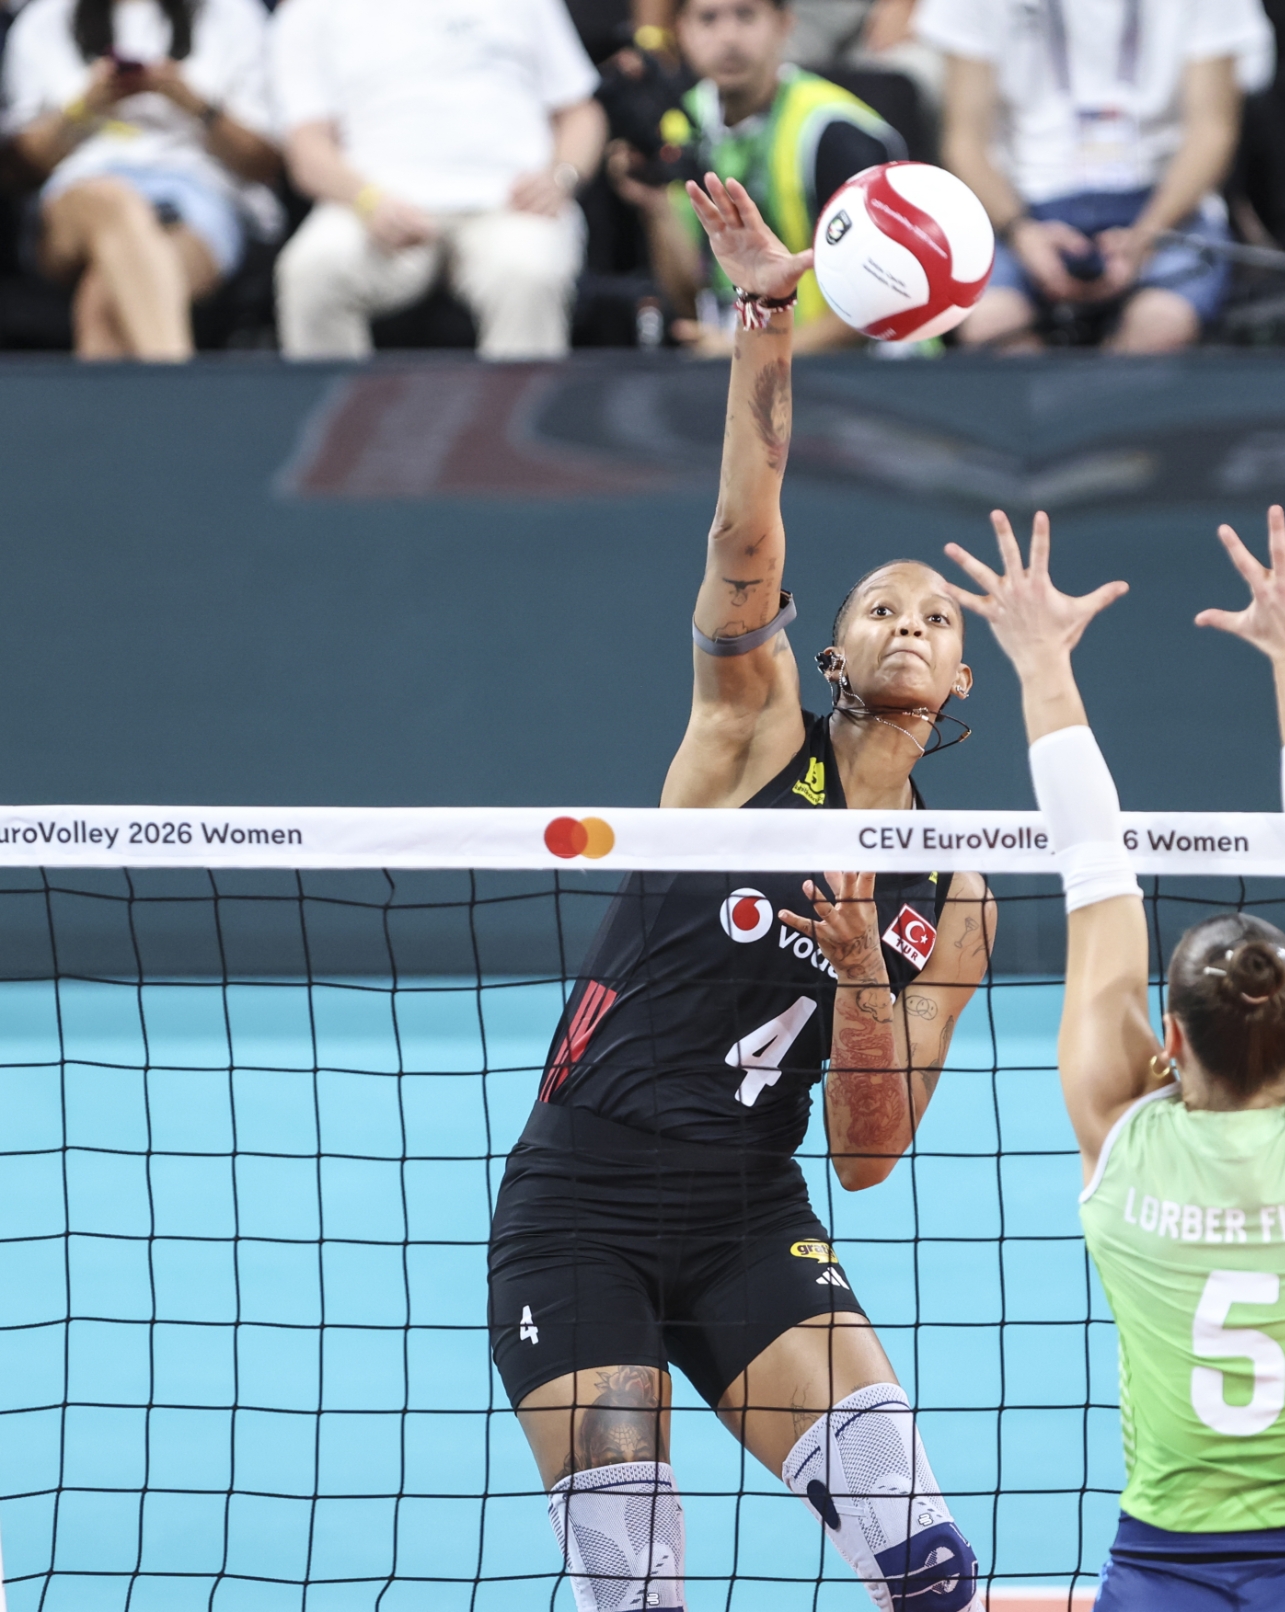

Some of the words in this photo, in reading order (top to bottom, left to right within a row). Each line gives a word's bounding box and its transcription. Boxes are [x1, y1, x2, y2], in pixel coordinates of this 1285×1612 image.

[0, 820, 119, 849] uroVolley
[129, 822, 193, 844] 2026
[201, 822, 303, 845] Women
[858, 828, 914, 849] CEV
[923, 827, 1049, 850] EuroVolle
[1147, 829, 1249, 852] Women
[895, 937, 919, 961] TUR
[724, 995, 818, 1107] 4
[1123, 1186, 1247, 1243] LORBER
[519, 1305, 539, 1345] 4
